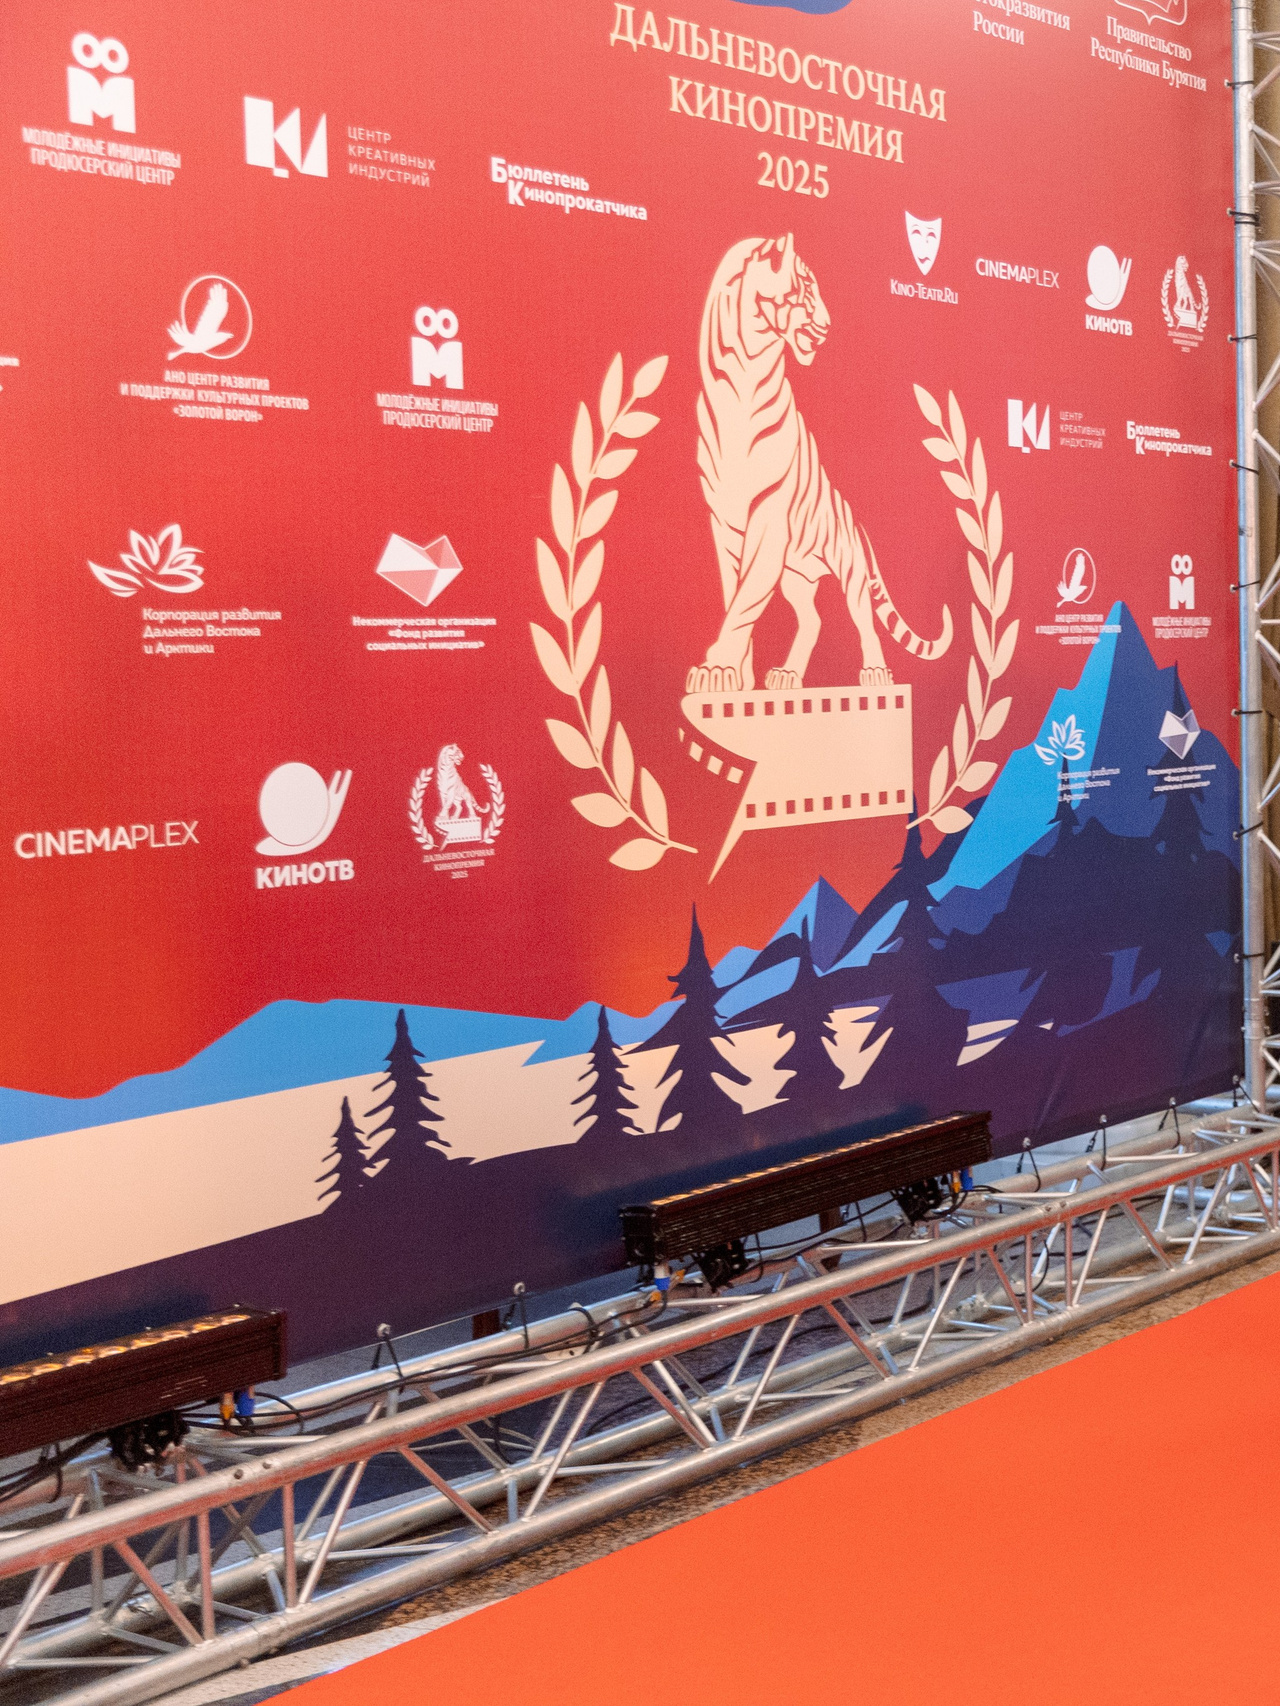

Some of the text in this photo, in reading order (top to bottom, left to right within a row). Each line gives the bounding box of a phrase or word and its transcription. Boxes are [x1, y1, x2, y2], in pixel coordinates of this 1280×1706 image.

[972, 10, 1025, 45] России
[1106, 16, 1192, 62] Правительство
[609, 3, 948, 122] ДАЛЬНЕВОСТОЧНАЯ
[1090, 37, 1207, 91] Республики Бурятия
[668, 75, 905, 164] КИНОПРЕМИЯ
[22, 126, 182, 169] МОЛОДЁЖНЫЕ ИНИЦИАТИВЫ
[347, 126, 392, 145] ЦЕНТР
[30, 147, 175, 186] ПРОДЮСЕРСКИЙ ЦЕНТР
[348, 144, 436, 171] КРЕАТИВНЫХ
[348, 162, 431, 188] ИНДУСТРИЙ
[491, 156, 590, 192] Бюллетень
[756, 151, 830, 199] 2025
[508, 179, 648, 221] Кинопрокатчика
[975, 257, 1060, 289] CINEMAPLEX
[1085, 314, 1133, 336] КИНОТВ
[164, 369, 271, 391] АНО ЦЕНТР РАЗВИТИЯ
[120, 382, 310, 411] И ПОДДЕРЖКИ КУЛЬТУРНЫХ ПРОЕКТОВ
[462, 416, 494, 434] ЦЕНТР
[1059, 411, 1083, 422] ЦЕНТР
[1059, 423, 1106, 437] КРЕАТИВНЫХ
[1126, 420, 1181, 440] Бюллетень
[1135, 436, 1213, 457] Кинопрокатчика
[142, 607, 282, 624] Корпорация развития
[142, 624, 262, 639] Дальнего Востока
[143, 641, 215, 658] и Арктики
[14, 820, 200, 859] CINEMAPLEX
[255, 859, 355, 889] КИНОТВ
